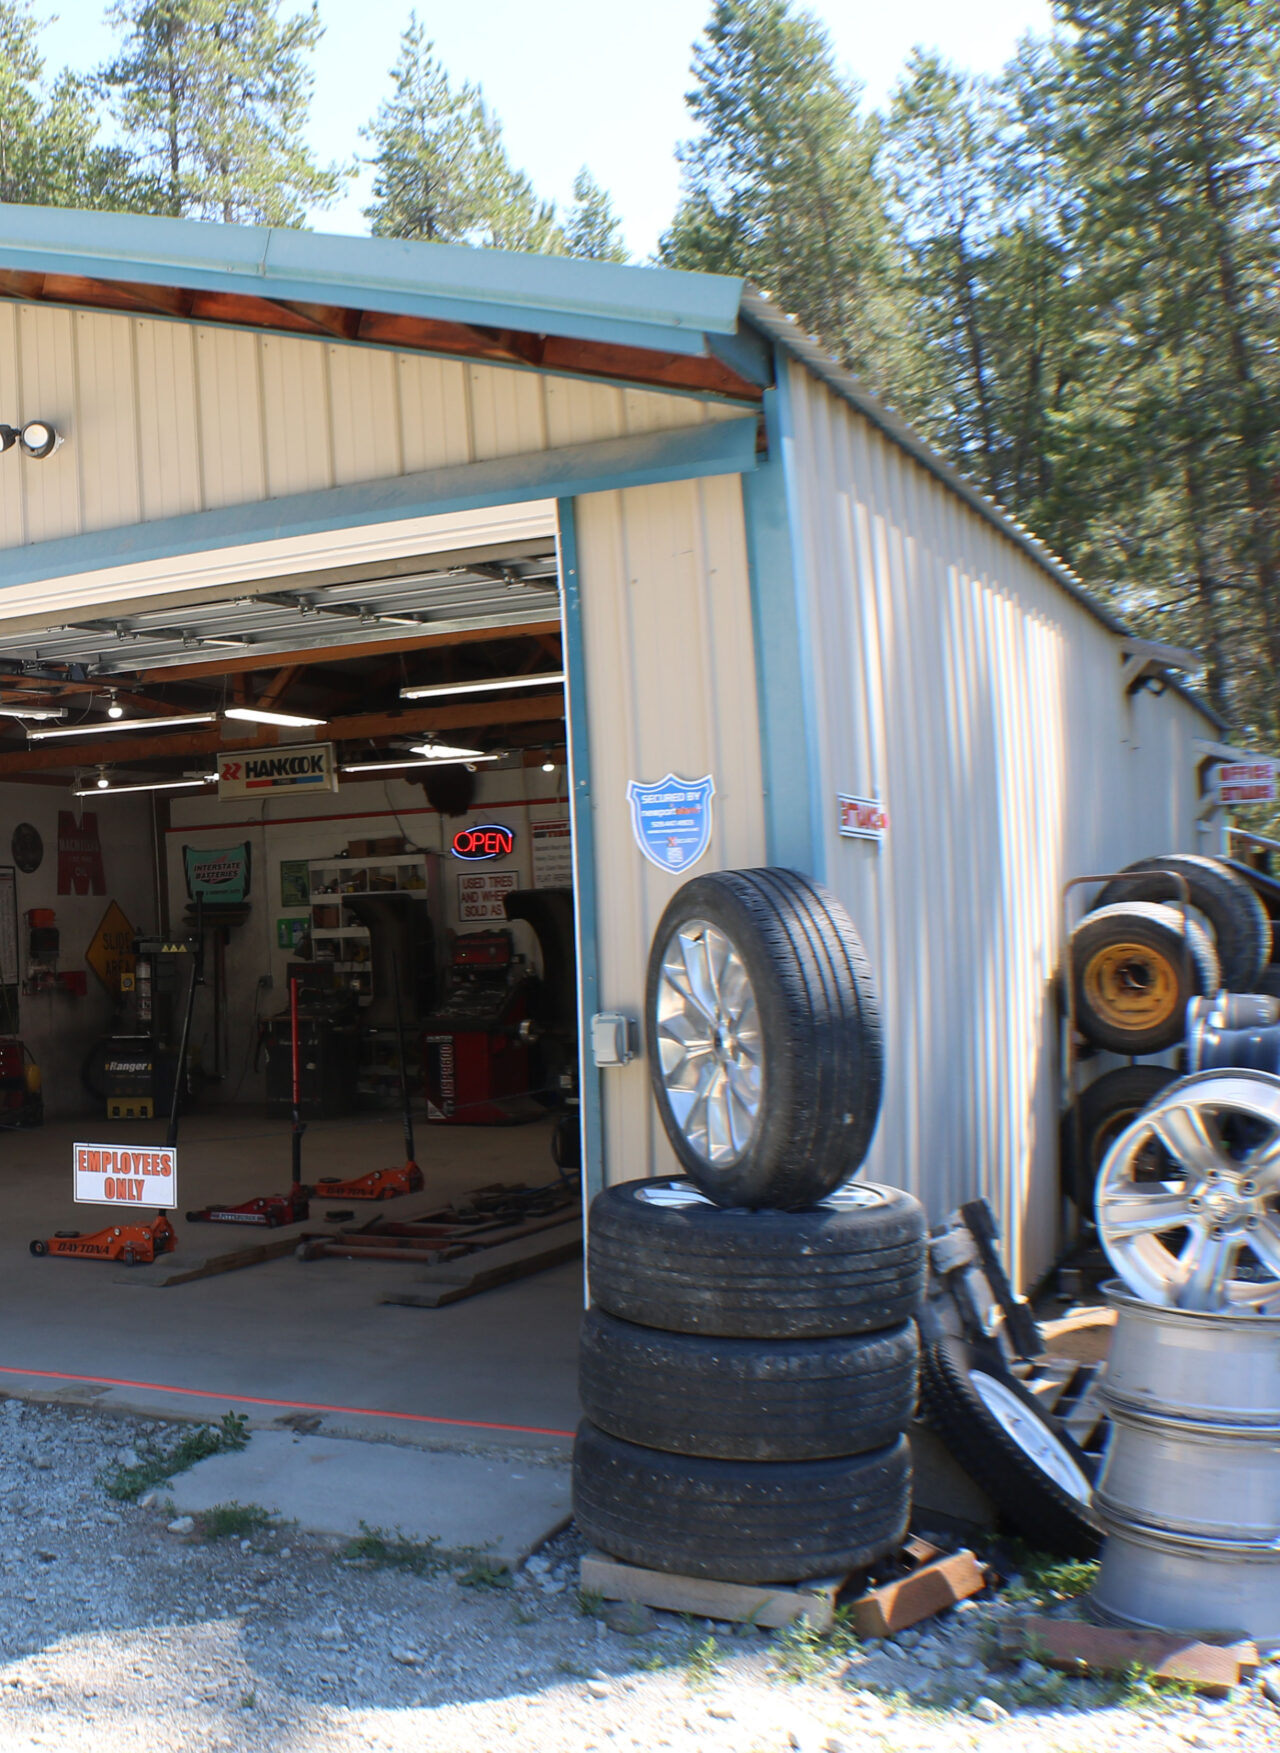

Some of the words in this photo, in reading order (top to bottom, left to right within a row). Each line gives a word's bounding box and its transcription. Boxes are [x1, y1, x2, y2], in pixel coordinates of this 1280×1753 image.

[245, 754, 324, 779] HANKOOK
[641, 791, 685, 804] SECURED
[686, 791, 702, 802] BY
[452, 830, 513, 854] OPEN
[193, 862, 241, 872] INTERSTATE
[195, 870, 239, 880] BATTERIES
[463, 877, 486, 889] USED
[488, 875, 513, 888] TIRES
[461, 891, 479, 903] AND
[481, 889, 510, 902] WHEE
[464, 904, 487, 917] SOLD
[490, 903, 503, 916] AS
[109, 1061, 148, 1073] Ranger
[78, 1149, 172, 1177] EMPLOYEES
[104, 1177, 145, 1201] ONLY
[57, 1242, 111, 1256] DAYTONA
